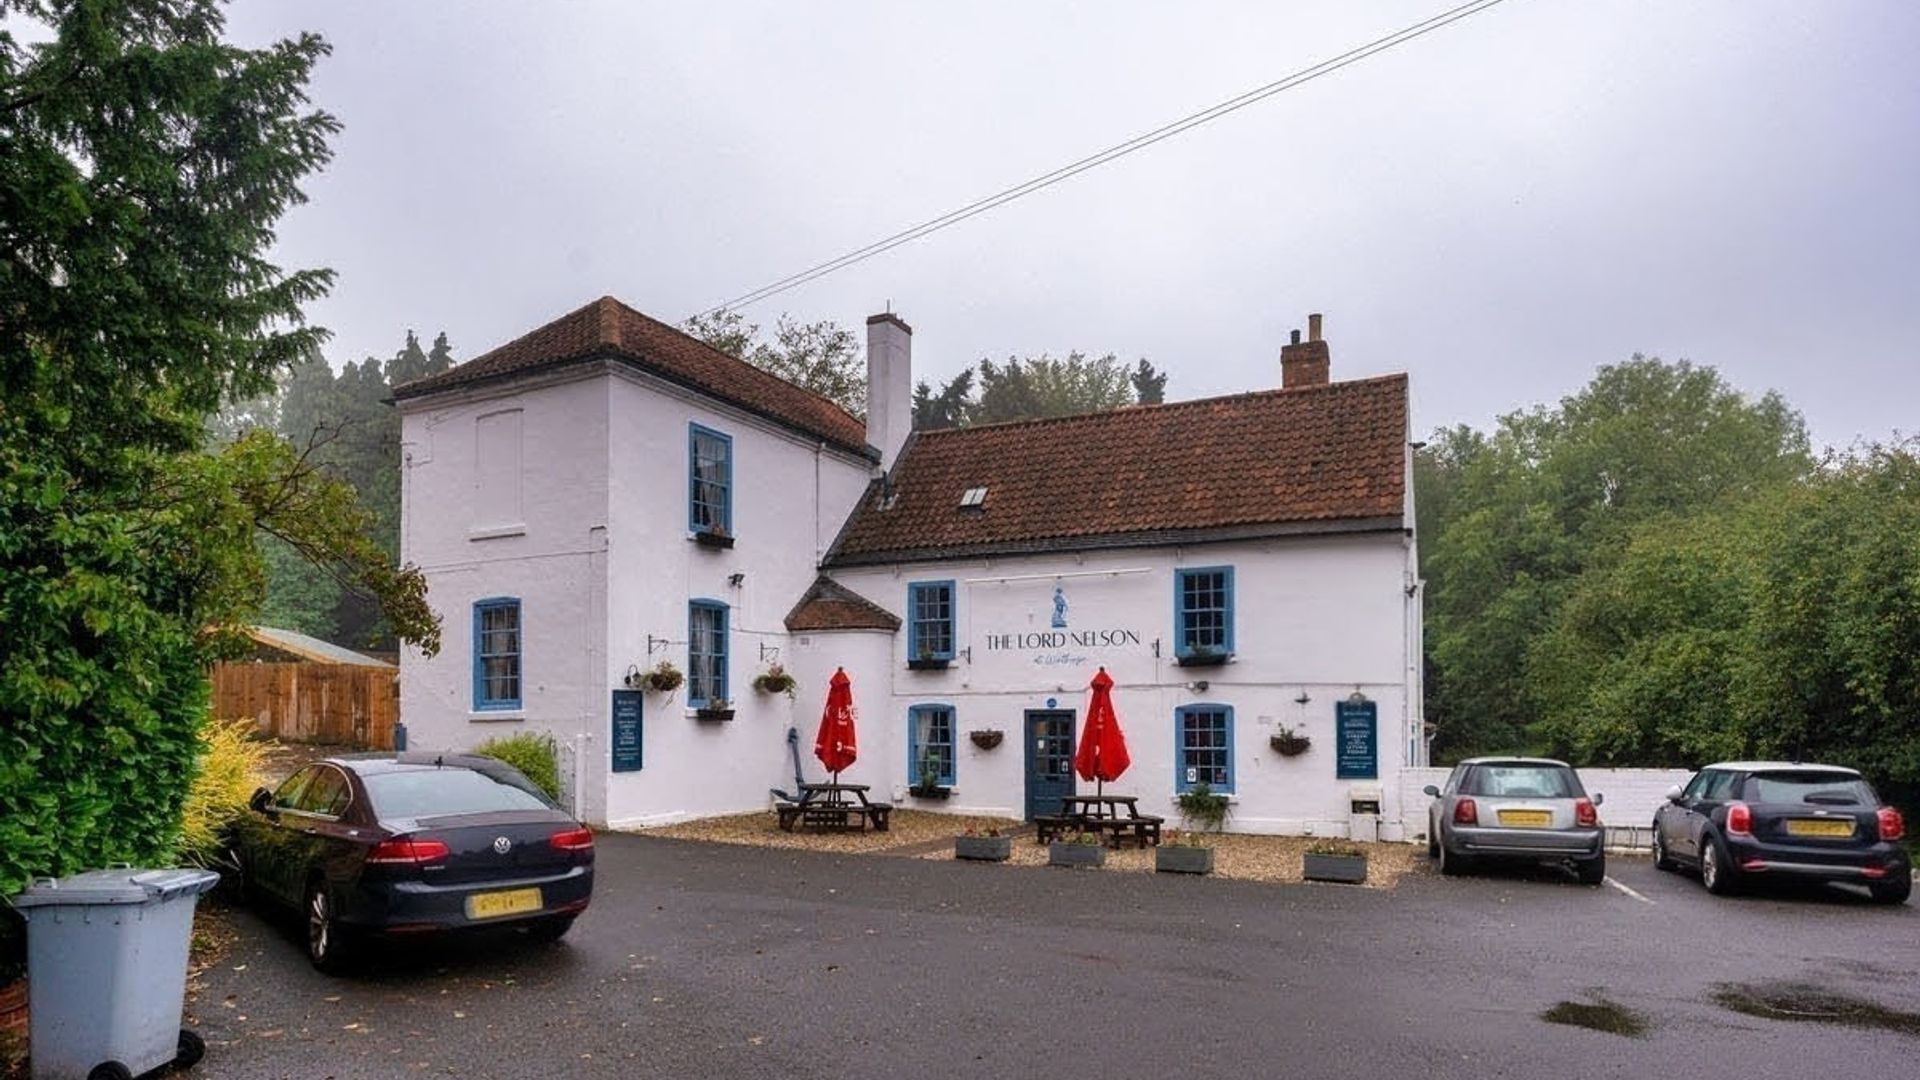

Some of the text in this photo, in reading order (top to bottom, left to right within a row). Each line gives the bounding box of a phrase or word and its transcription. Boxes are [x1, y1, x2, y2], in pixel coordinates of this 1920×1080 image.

[987, 630, 1141, 650] THE LORD NELSON
